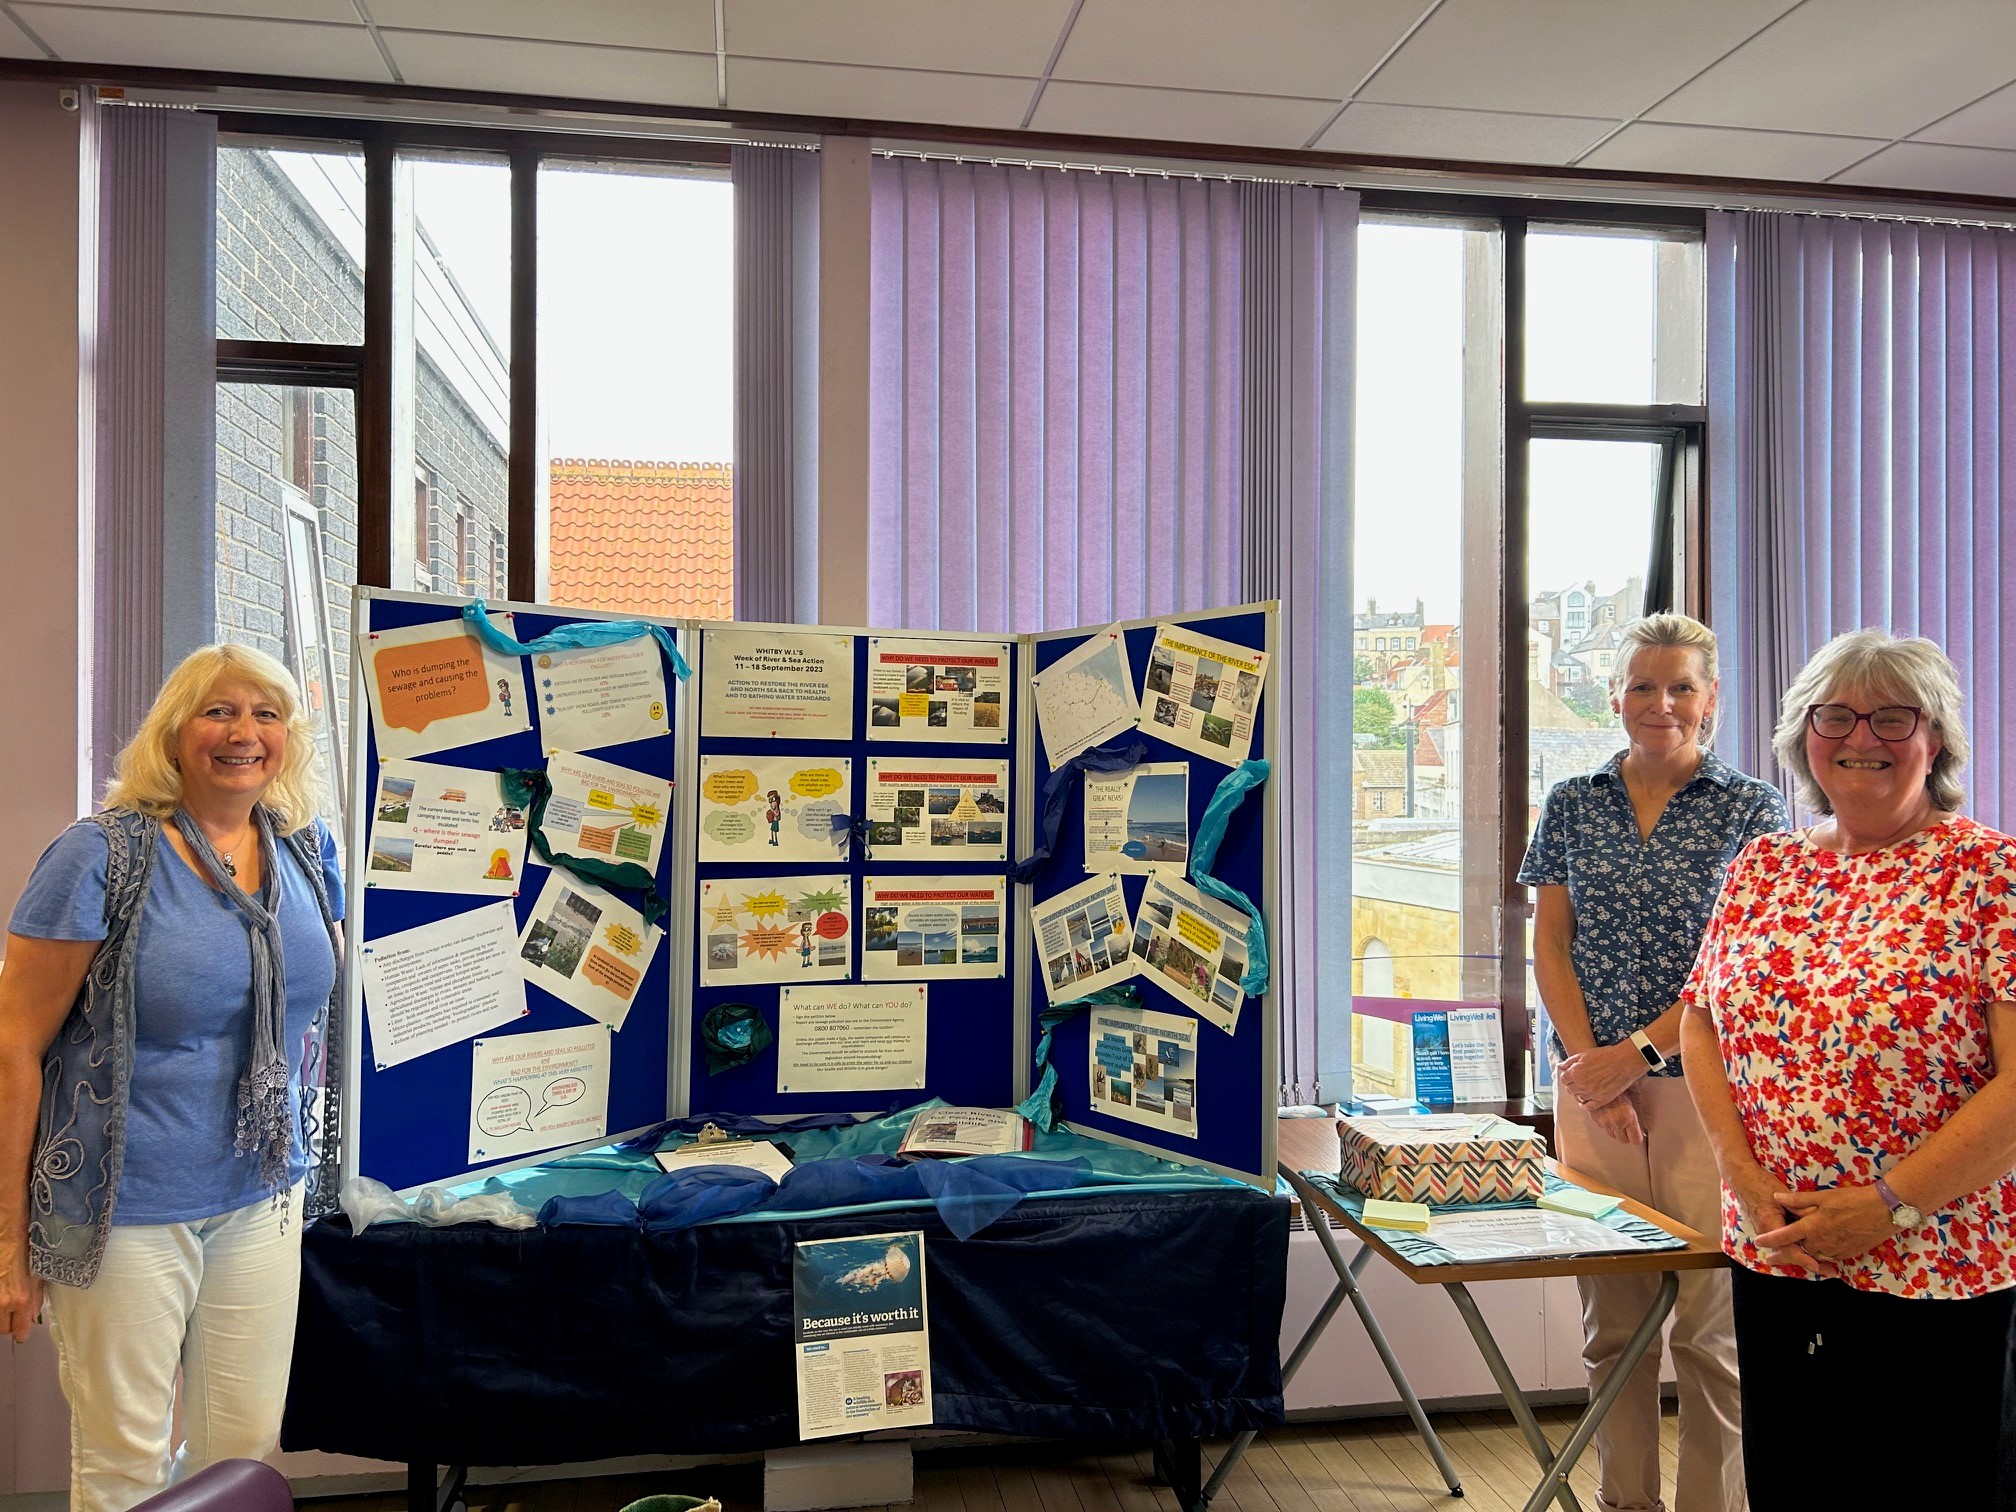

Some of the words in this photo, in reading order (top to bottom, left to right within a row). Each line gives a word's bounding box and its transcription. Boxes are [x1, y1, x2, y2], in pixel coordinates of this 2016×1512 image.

[1164, 639, 1175, 647] THE
[1174, 642, 1208, 657] IMPORTANCE
[1207, 651, 1217, 659] OF
[1215, 654, 1227, 662] THE
[1227, 657, 1243, 667] RIVER
[1243, 662, 1254, 670] ESK
[391, 667, 412, 678] Who
[412, 666, 419, 675] is
[420, 660, 455, 675] dumping
[456, 657, 470, 667] the
[761, 665, 803, 673] September
[387, 681, 417, 695] sewage
[417, 676, 433, 687] and
[434, 671, 464, 685] causing
[464, 668, 478, 678] the
[415, 686, 456, 703] problems?
[1450, 1013, 1484, 1022] LivingWell
[1109, 1020, 1141, 1031] IMPORTANCE
[1159, 1030, 1179, 1039] NORTH
[1179, 1033, 1190, 1041] SEA!
[801, 1314, 850, 1329] Because
[851, 1312, 868, 1324] it's
[869, 1309, 908, 1322] worth
[908, 1307, 918, 1319] it
